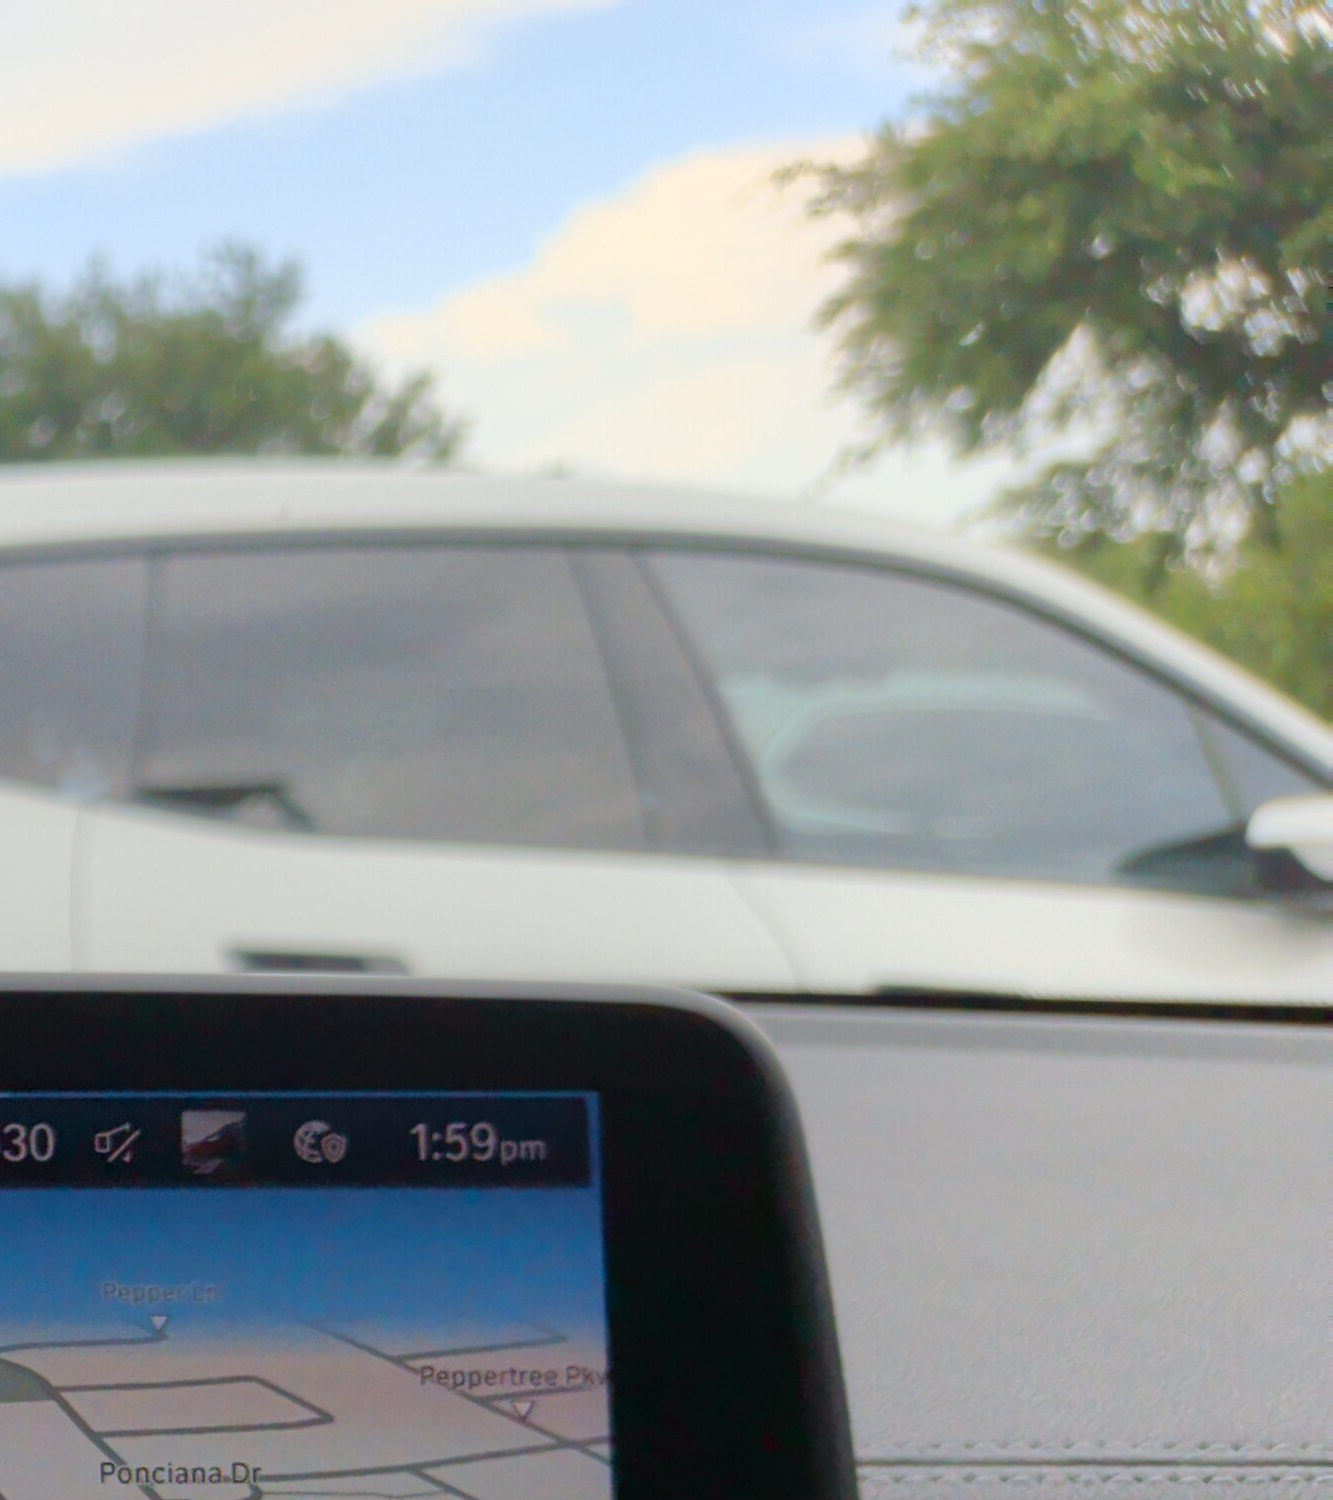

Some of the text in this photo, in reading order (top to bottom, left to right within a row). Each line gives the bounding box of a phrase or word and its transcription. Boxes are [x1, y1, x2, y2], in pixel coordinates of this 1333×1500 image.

[420, 1366, 558, 1389] Peppertree
[100, 1461, 262, 1484] Ponciana Dr
